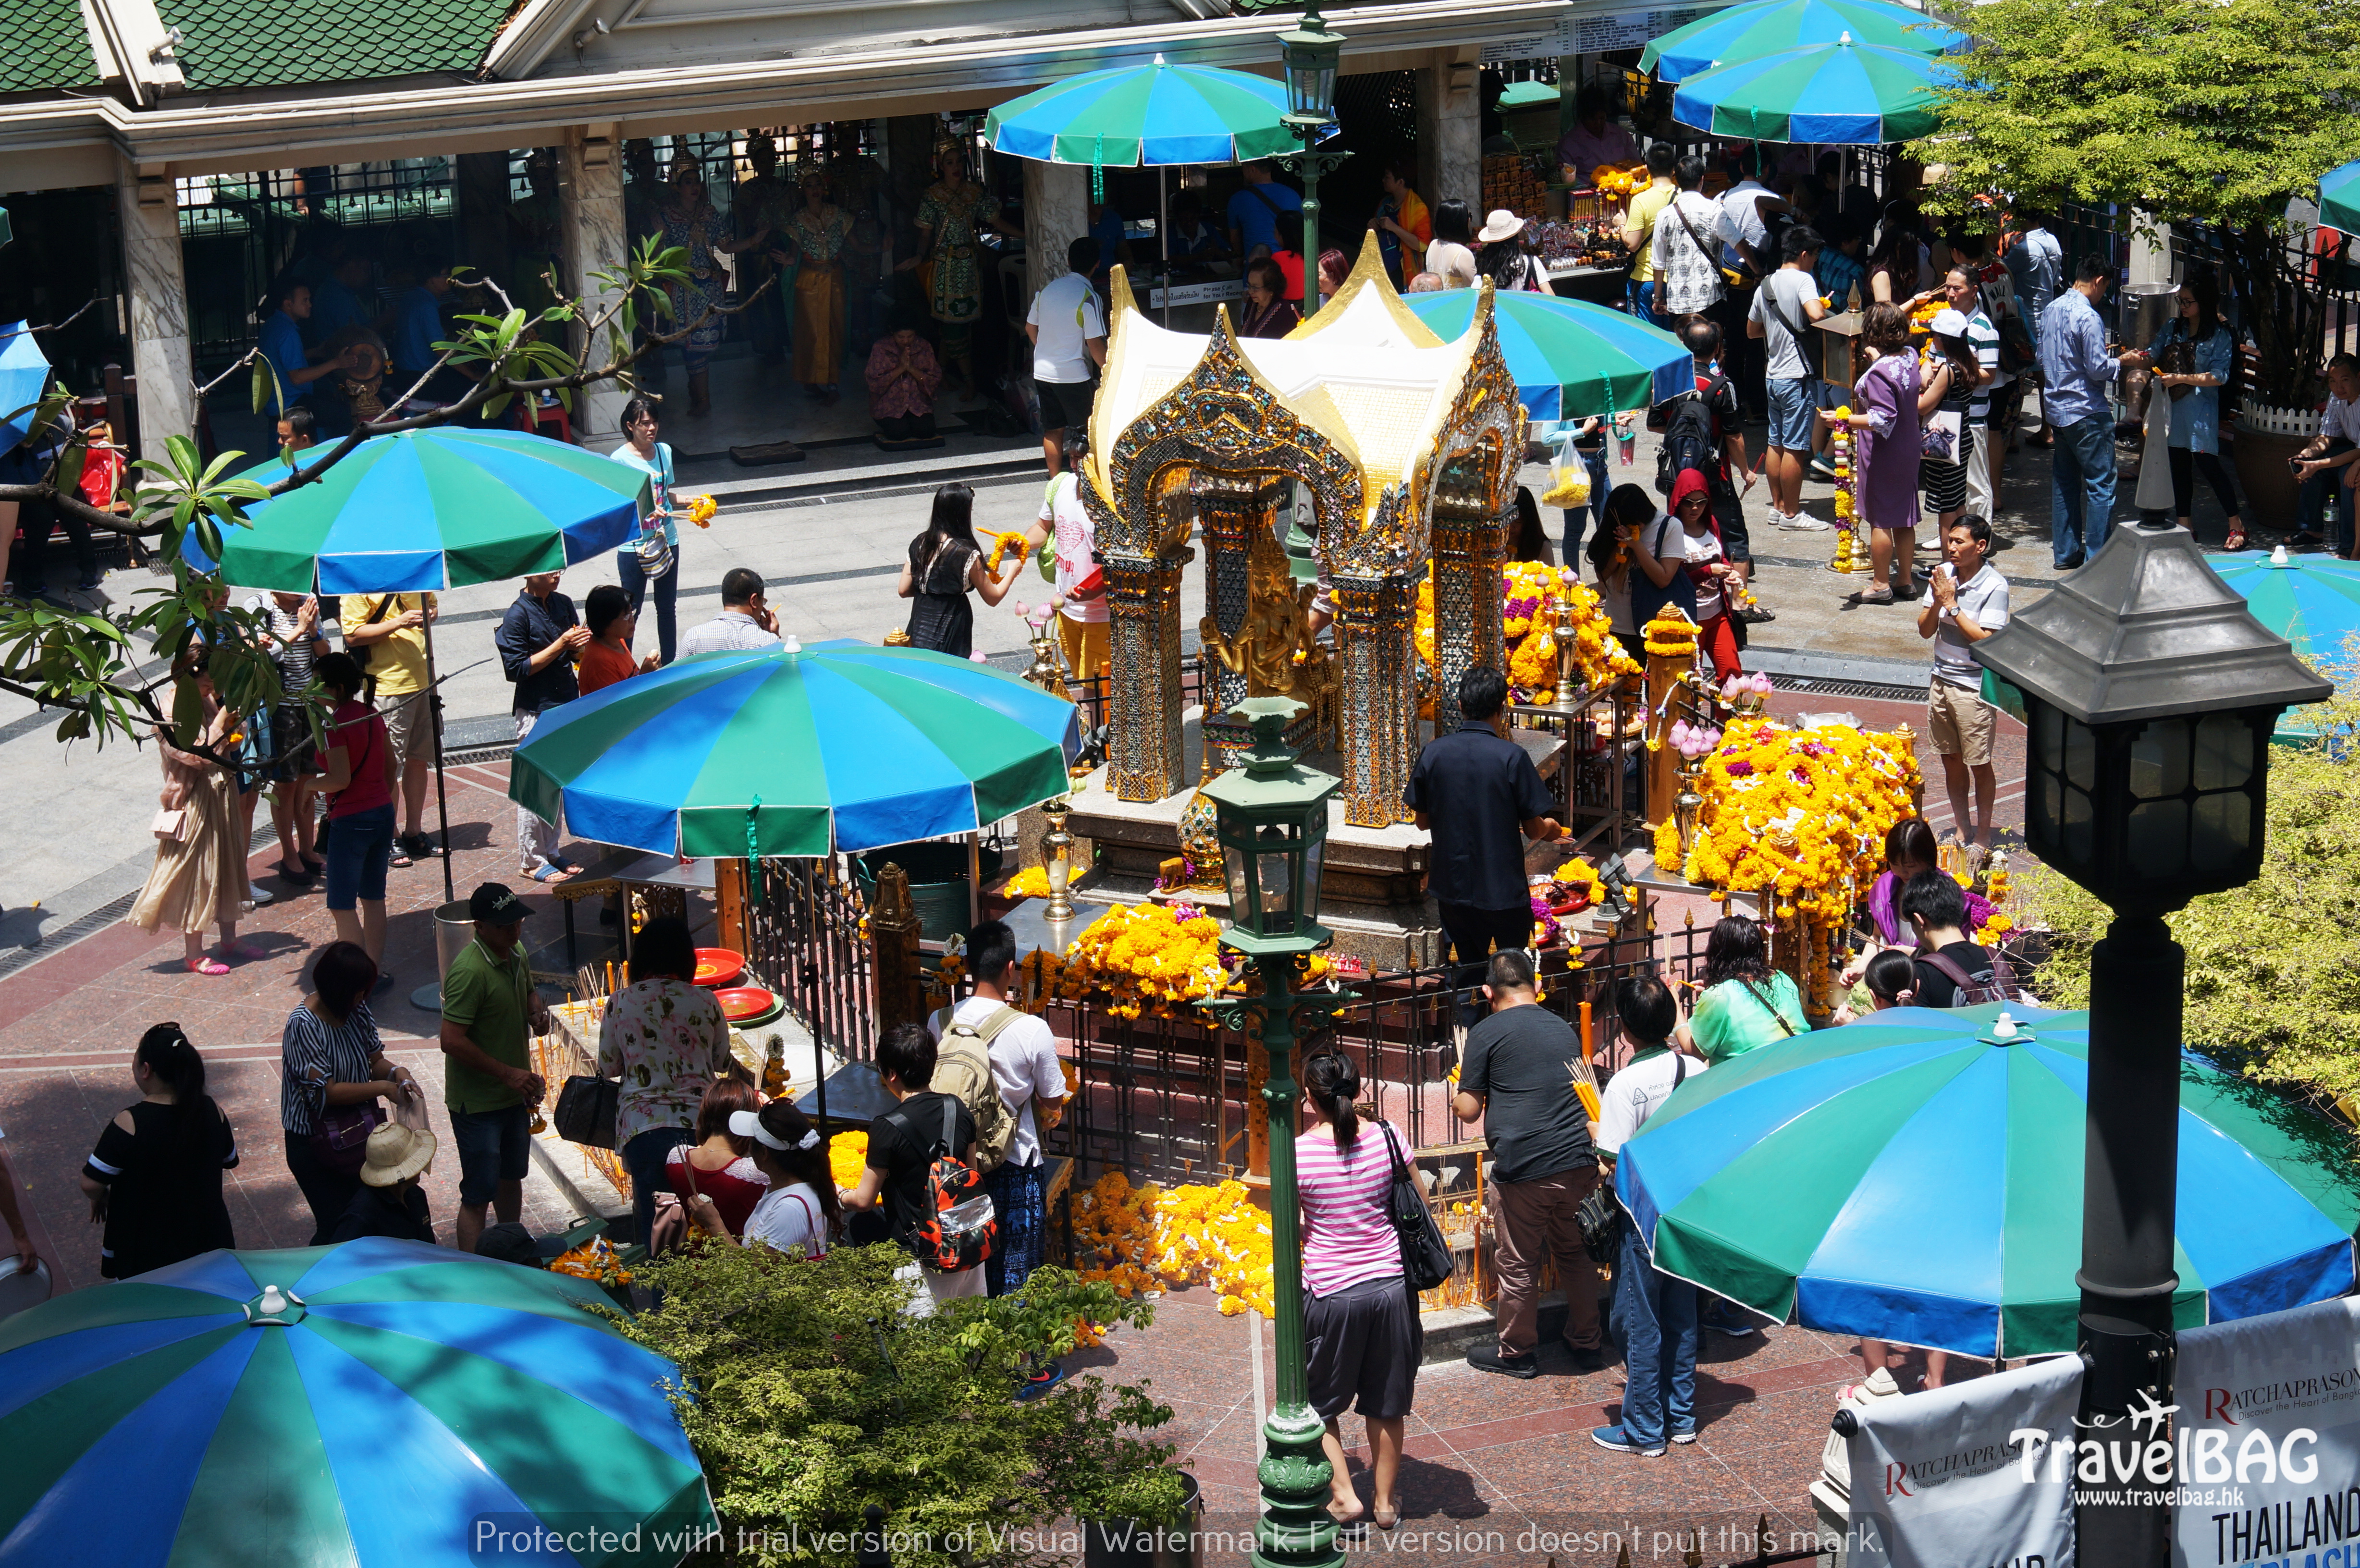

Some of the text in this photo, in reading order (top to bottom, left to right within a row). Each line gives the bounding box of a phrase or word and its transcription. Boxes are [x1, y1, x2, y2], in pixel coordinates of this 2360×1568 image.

[1989, 285, 2005, 301] WALL
[2239, 1407, 2273, 1421] Discover
[2276, 1402, 2289, 1411] the
[2294, 1398, 2319, 1409] Heart
[2322, 1393, 2329, 1403] of
[1913, 1476, 1950, 1491] Discover
[1954, 1471, 1966, 1481] the
[1970, 1465, 1994, 1476] Heart
[1997, 1459, 2005, 1469] of
[2212, 1486, 2360, 1565] THAILAND
